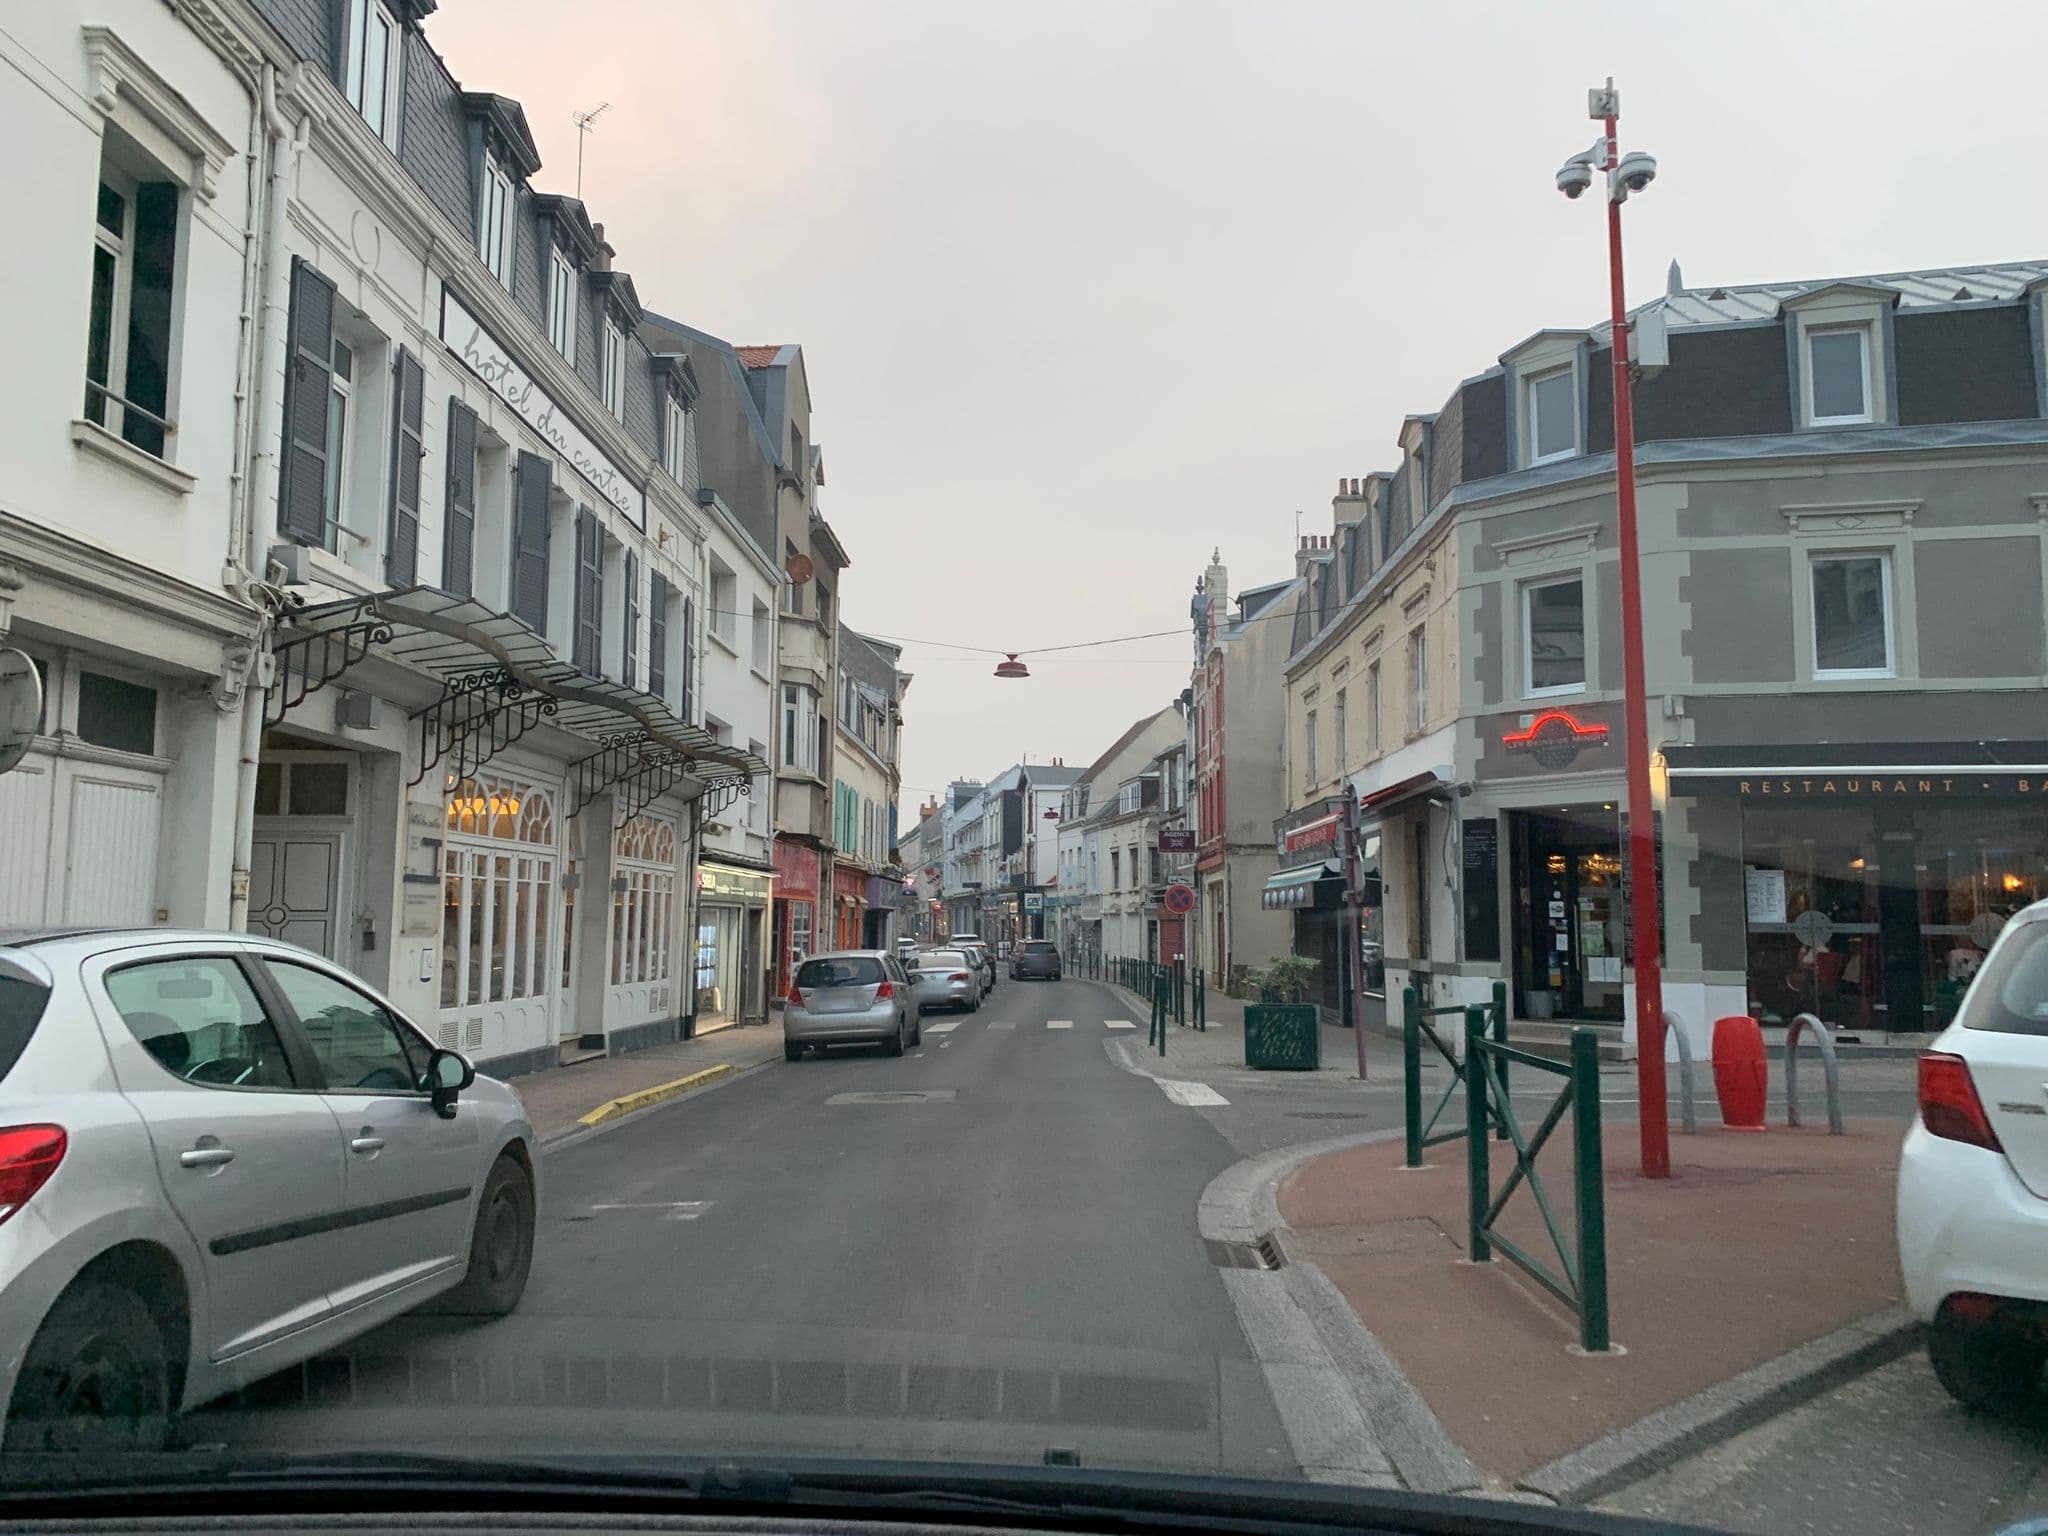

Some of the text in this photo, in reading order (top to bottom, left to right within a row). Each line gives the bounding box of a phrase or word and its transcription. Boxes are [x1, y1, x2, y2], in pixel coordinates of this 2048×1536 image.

[464, 327, 630, 511] hôtel du centre
[1740, 780, 1954, 793] RESTAURANT
